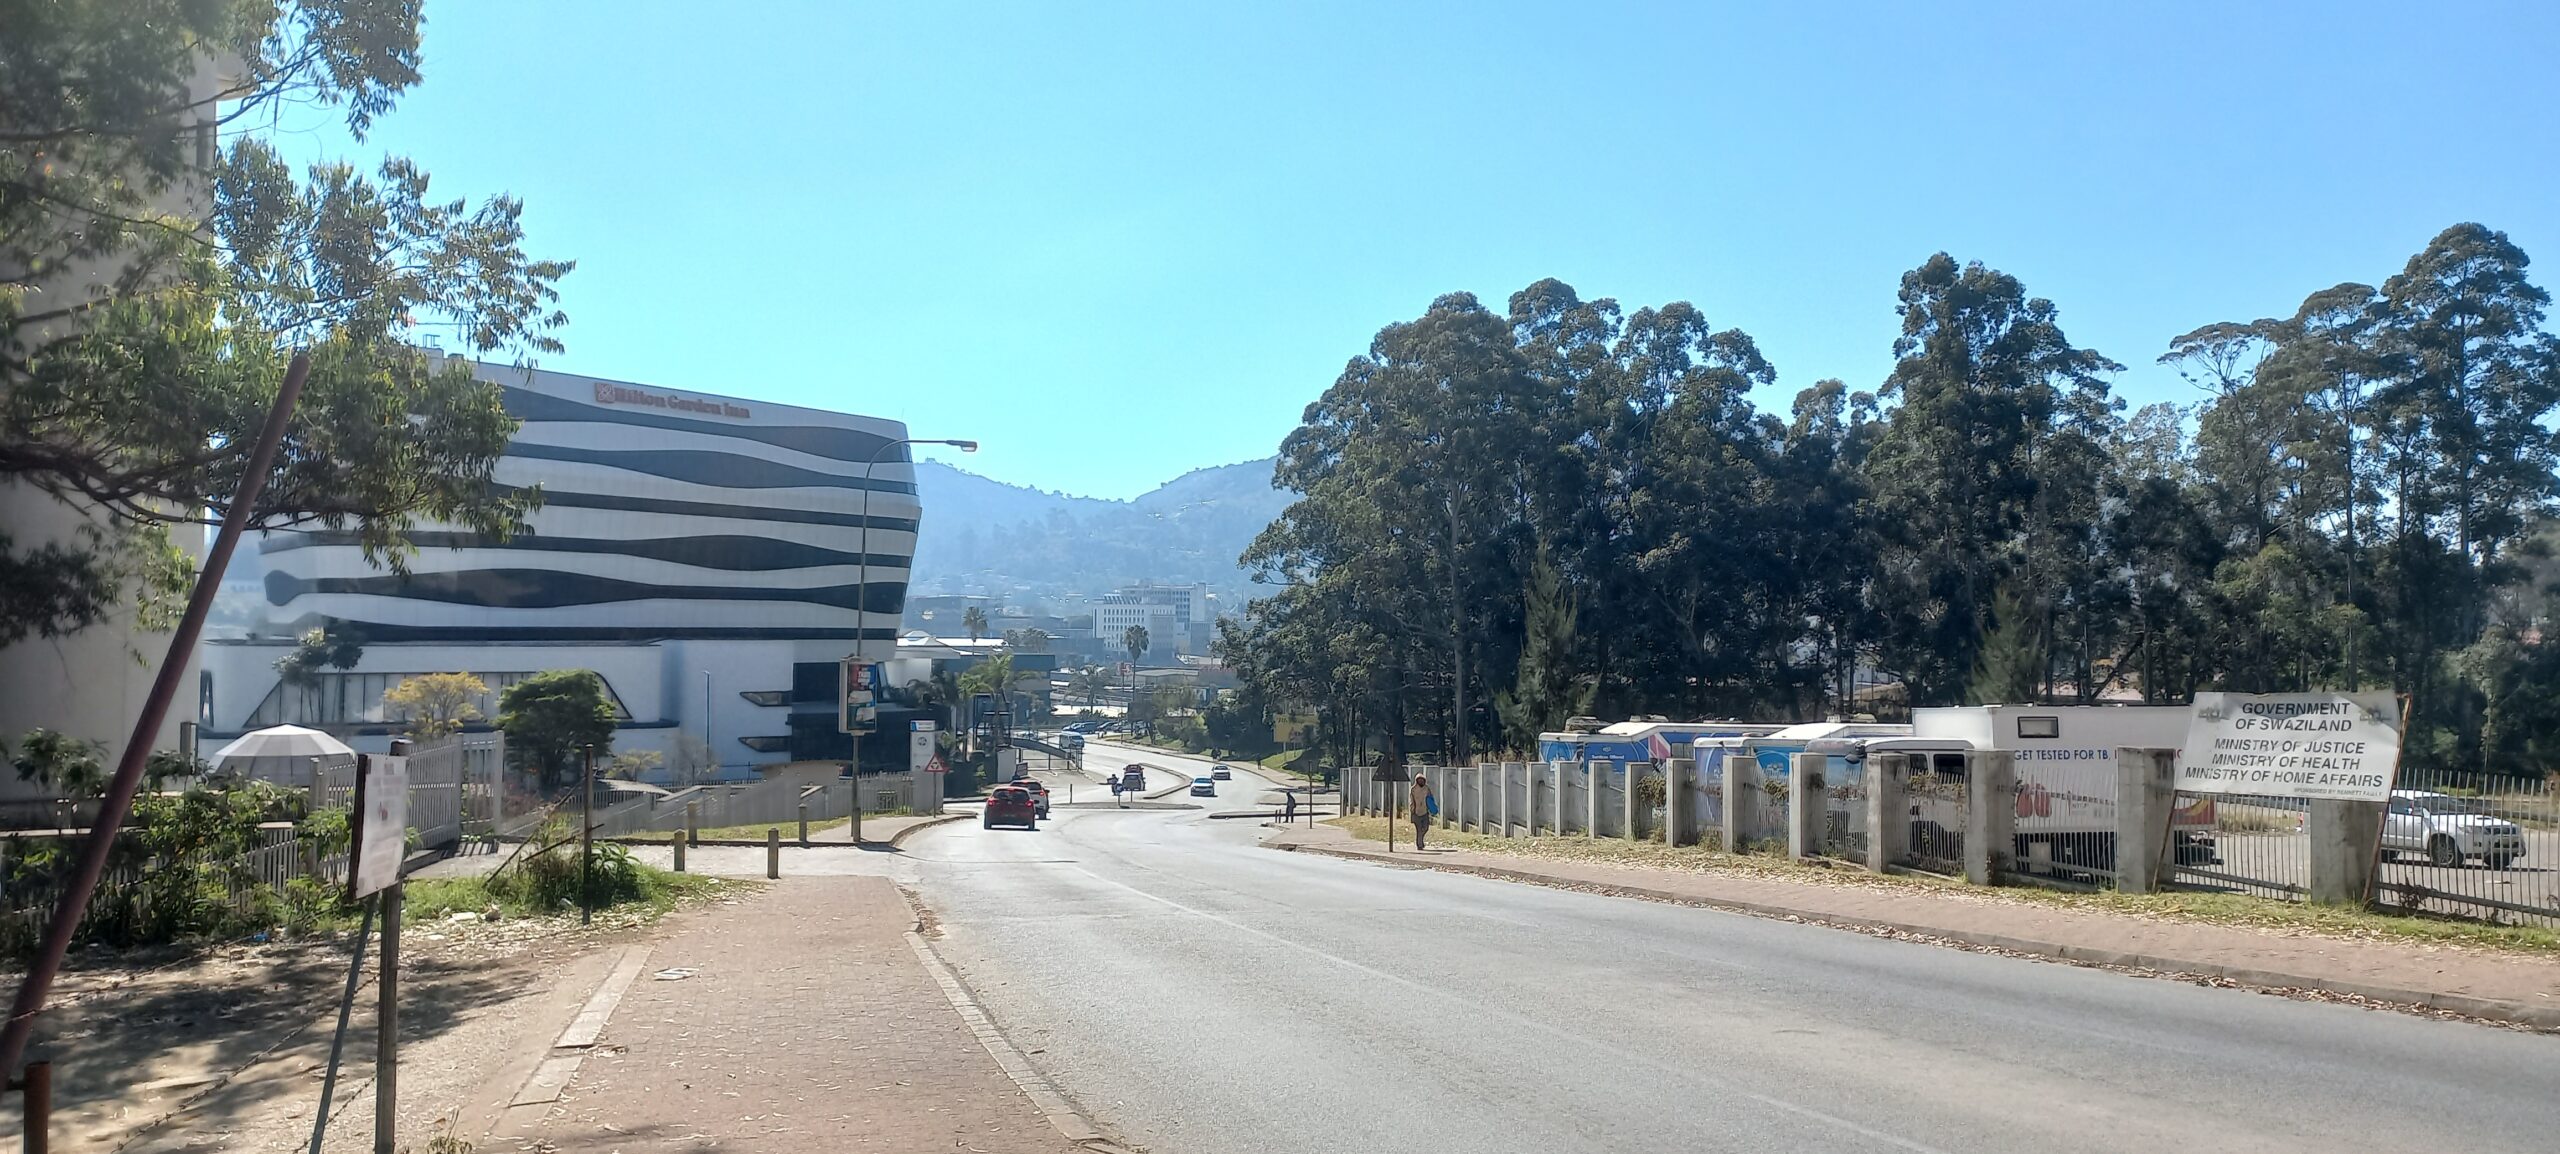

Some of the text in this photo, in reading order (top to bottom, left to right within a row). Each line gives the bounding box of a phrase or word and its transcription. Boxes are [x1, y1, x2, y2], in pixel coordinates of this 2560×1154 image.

[615, 387, 750, 419] Hilton Garden Inn
[2242, 702, 2350, 715] GOVERNMENT
[2235, 718, 2352, 731] OF SWAZILAND
[2214, 738, 2366, 754] MINISTRY OF JUSTICE
[2014, 750, 2033, 761] GET
[2036, 750, 2071, 760] TESTED
[2074, 750, 2094, 760] FOR
[2096, 750, 2111, 761] TB,
[2211, 753, 2361, 770] MINISTRY OF HEALTH
[2185, 767, 2383, 787] MINISTRY OF HOME AFFAIRS
